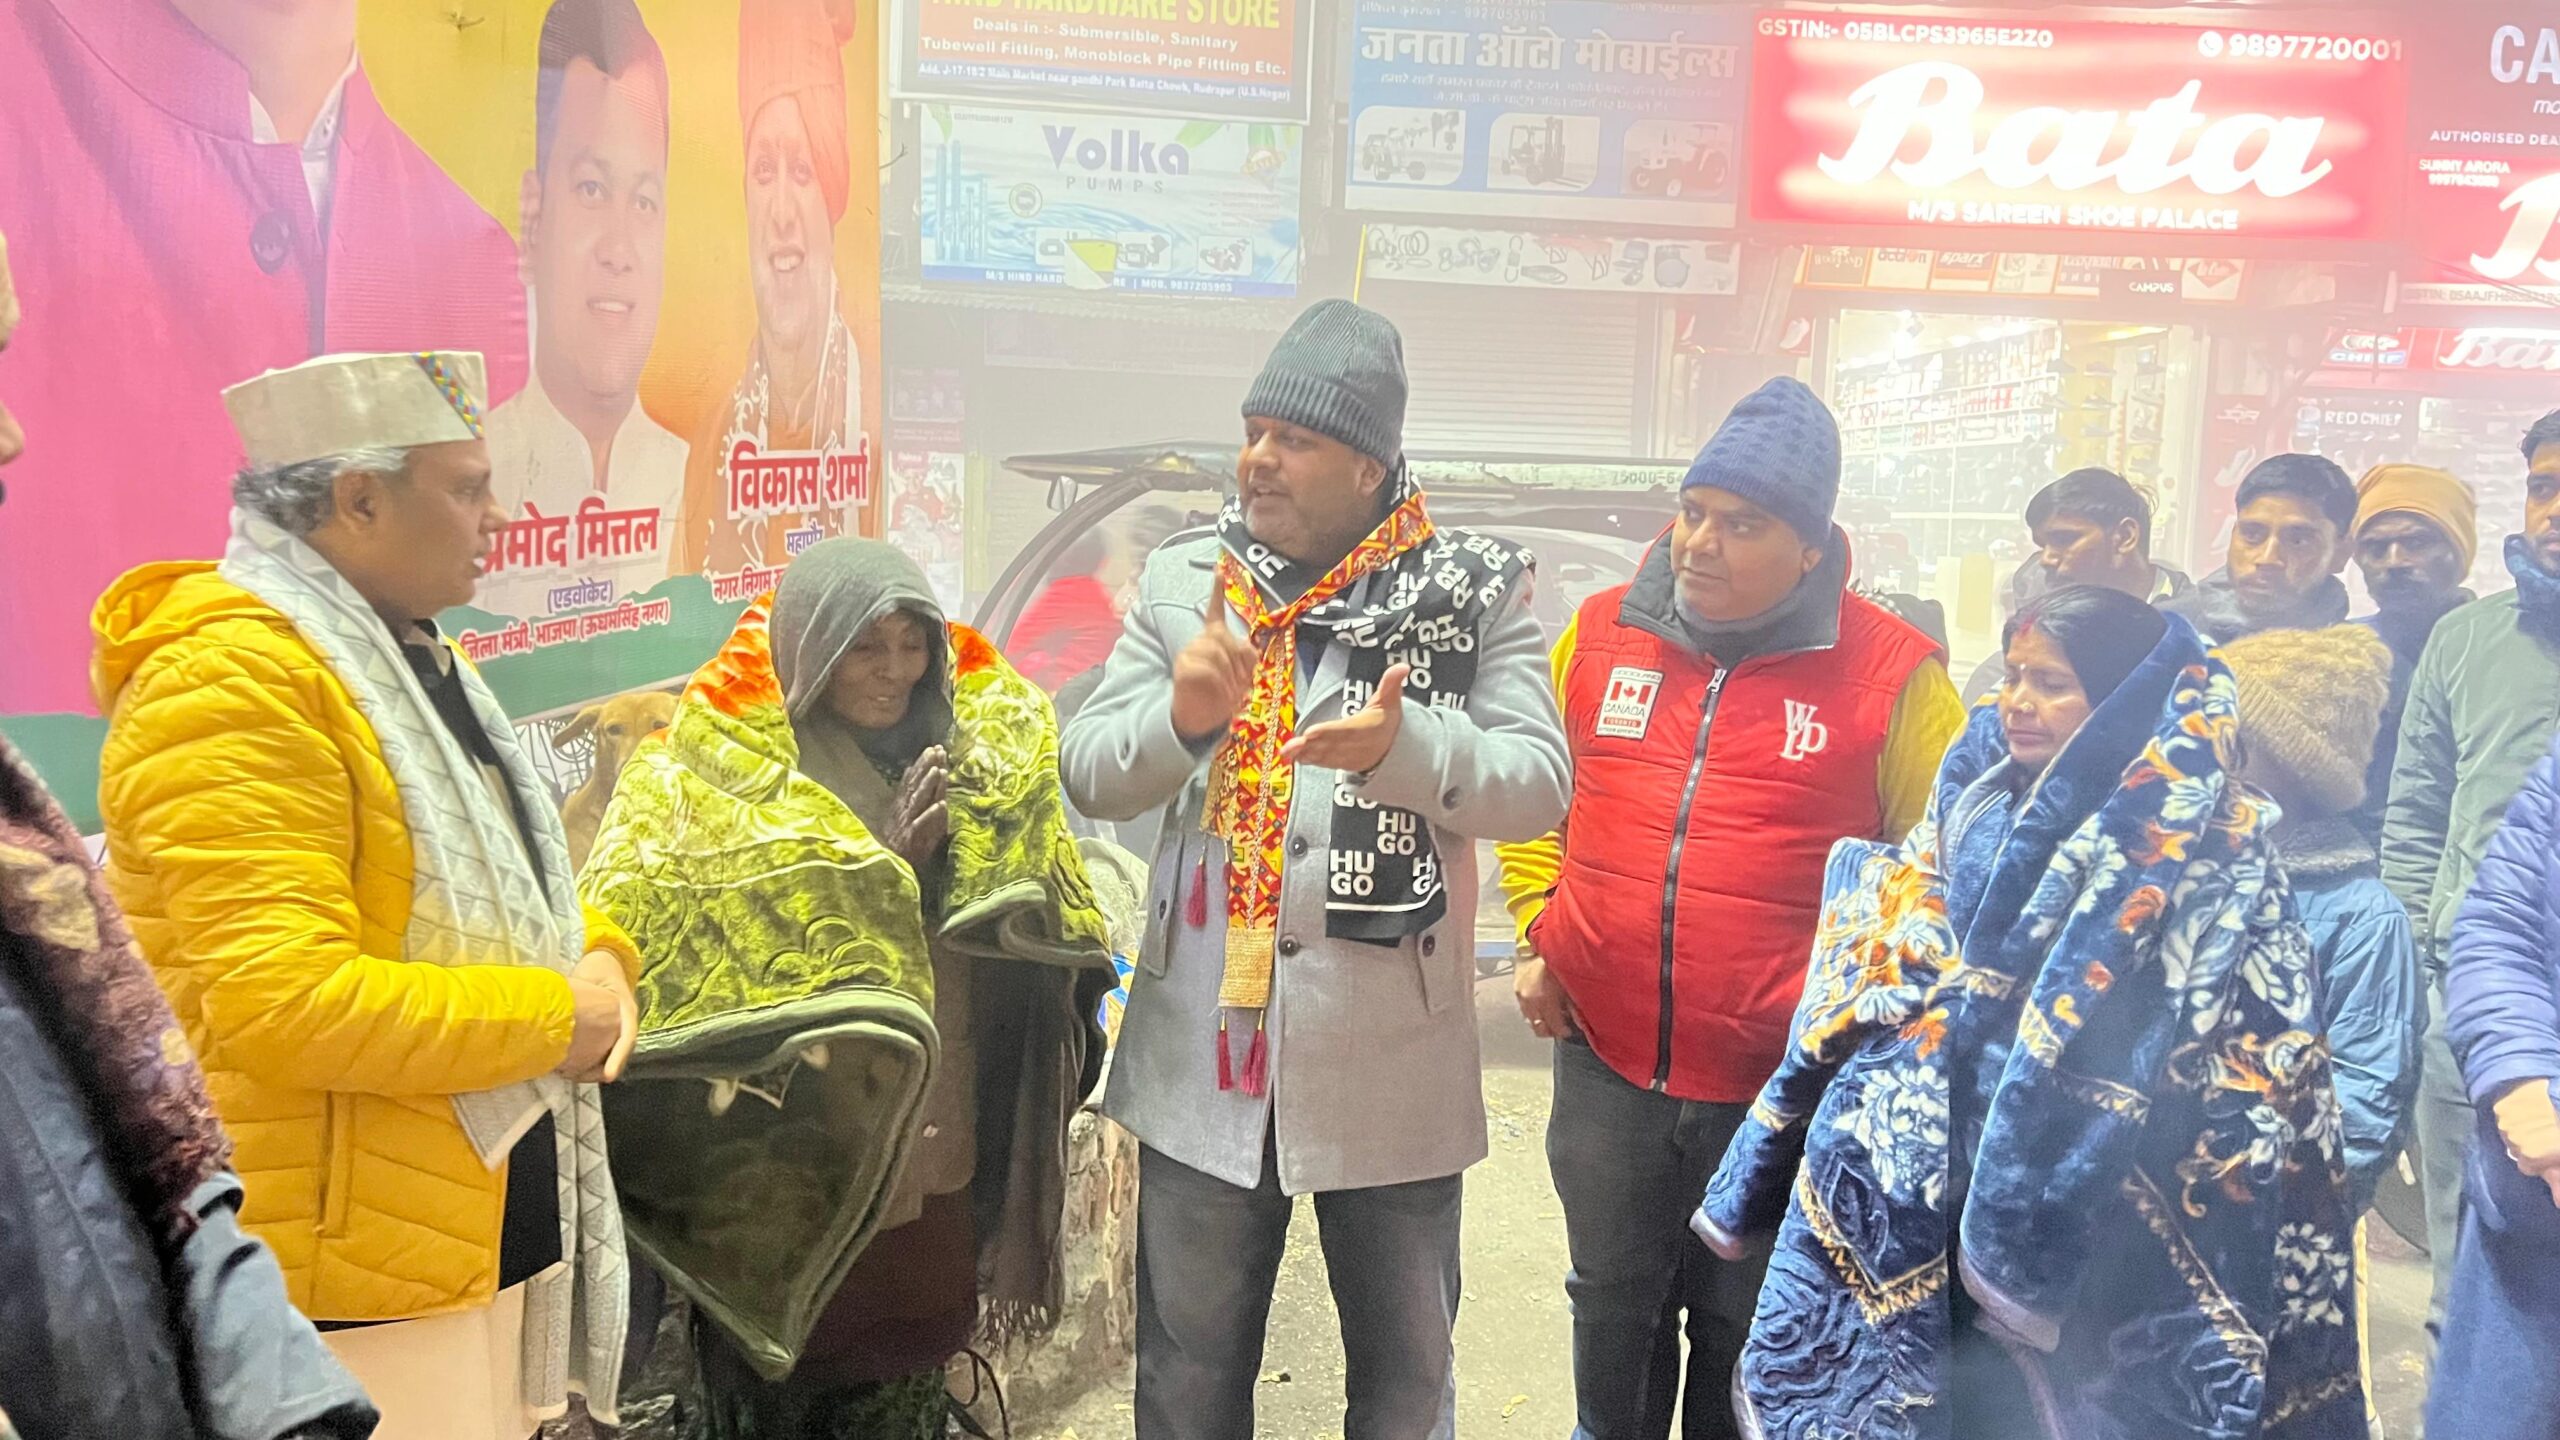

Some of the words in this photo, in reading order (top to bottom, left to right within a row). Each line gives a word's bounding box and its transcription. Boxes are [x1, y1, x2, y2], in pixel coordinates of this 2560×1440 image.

[973, 17, 1018, 33] Deals
[1024, 20, 1038, 34] in
[1059, 23, 1165, 45] Submersible,
[1170, 32, 1238, 52] Sanitary
[921, 37, 995, 53] Tubewell
[1001, 42, 1058, 60] Fitting,
[1064, 46, 1152, 65] Monoblock
[1157, 53, 1192, 69] Pipe
[1198, 57, 1249, 75] Fitting
[1255, 61, 1286, 75] Etc.
[1360, 27, 1470, 65] जनता
[1475, 26, 1566, 70] ऑटो
[1575, 28, 1739, 81] मोबाईल्स
[2228, 36, 2402, 60] 9897720001
[1013, 69, 1045, 81] Market
[1048, 74, 1069, 83] near
[1072, 74, 1103, 86] gandhi
[1105, 76, 1126, 87] Park
[1157, 80, 1191, 92] Chowk,
[1194, 83, 1235, 97] Rudrapur
[1817, 60, 2332, 197] Bata
[2430, 130, 2525, 145] AUTHORISED
[1041, 125, 1189, 175] Volka
[2464, 161, 2511, 174] ARORA
[1908, 201, 1956, 221] M/S
[1962, 203, 2060, 225] SAREEN
[2068, 206, 2135, 228] SHOE
[2141, 207, 2239, 230] PALACE
[1008, 272, 1032, 283] HIND
[2128, 282, 2175, 293] CAMPUS
[2325, 411, 2358, 425] RED
[729, 440, 820, 512] विकास
[826, 437, 868, 502] शर्मा
[575, 496, 660, 560] मित्तल
[547, 577, 613, 613] (एडवोकेट)
[713, 576, 739, 600] नगर
[742, 567, 772, 596] निगम
[460, 632, 498, 660] जिला
[502, 622, 532, 651] मंत्री,
[535, 618, 577, 644] भाजपा
[642, 600, 669, 622] नगर)
[1604, 703, 1645, 718] CANADA
[1605, 717, 1638, 727] TORONTO
[1377, 811, 1416, 834] HU
[1377, 832, 1416, 856] GO
[1330, 850, 1374, 874] HU
[1331, 873, 1374, 896] GO
